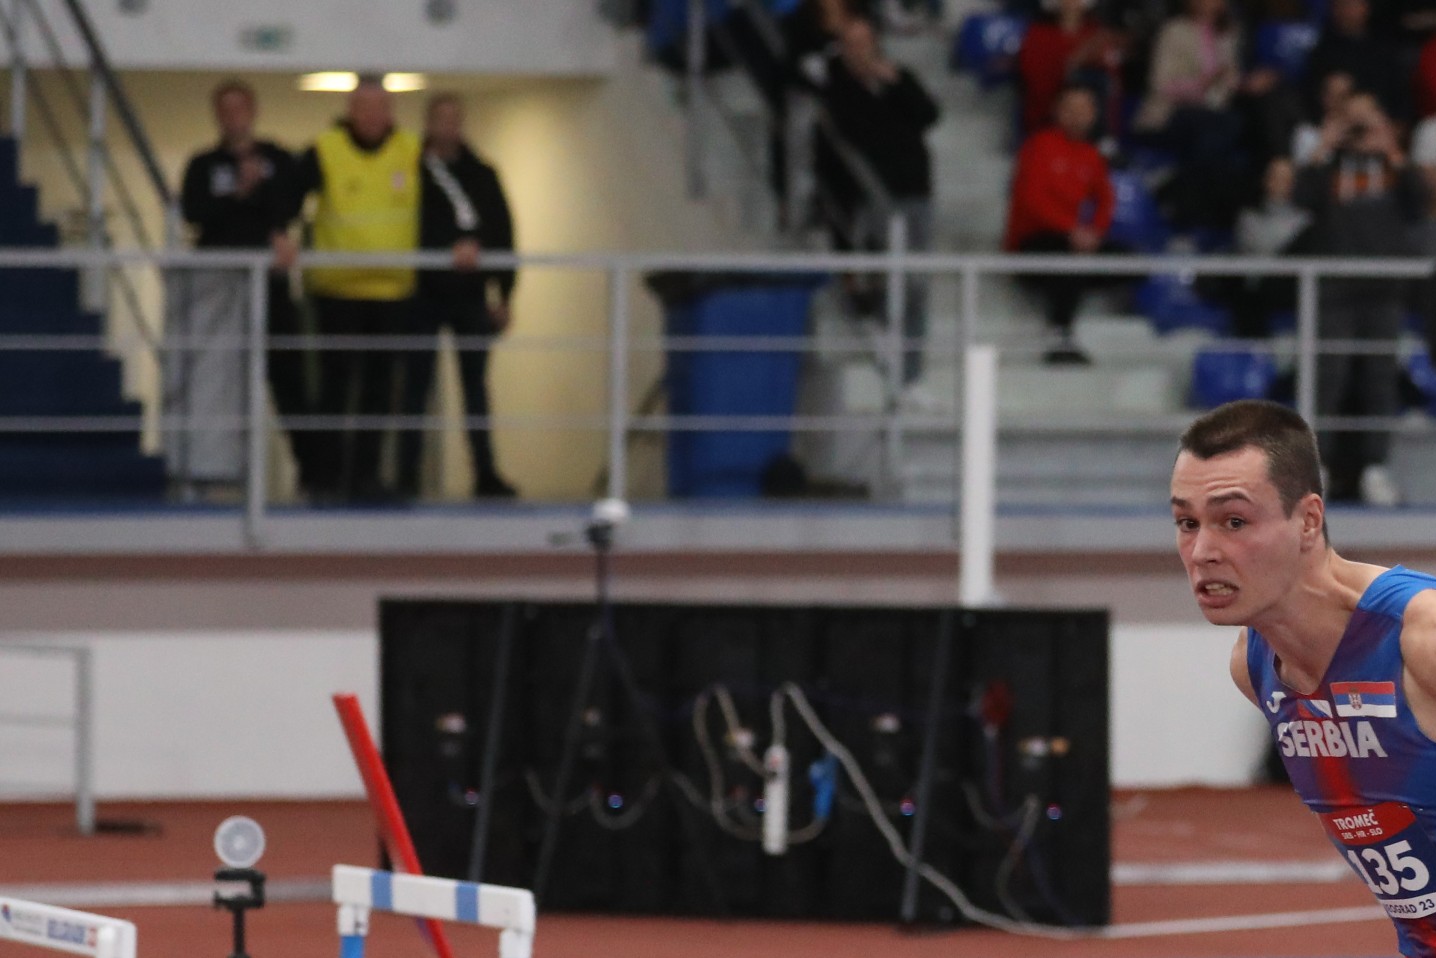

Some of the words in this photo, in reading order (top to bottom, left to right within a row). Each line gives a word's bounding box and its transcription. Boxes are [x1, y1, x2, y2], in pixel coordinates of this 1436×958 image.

[1277, 720, 1388, 758] SERBIA
[1333, 809, 1379, 830] TROMEČ
[1369, 827, 1383, 836] SLO
[1347, 840, 1430, 895] 135
[1418, 898, 1435, 911] 23
